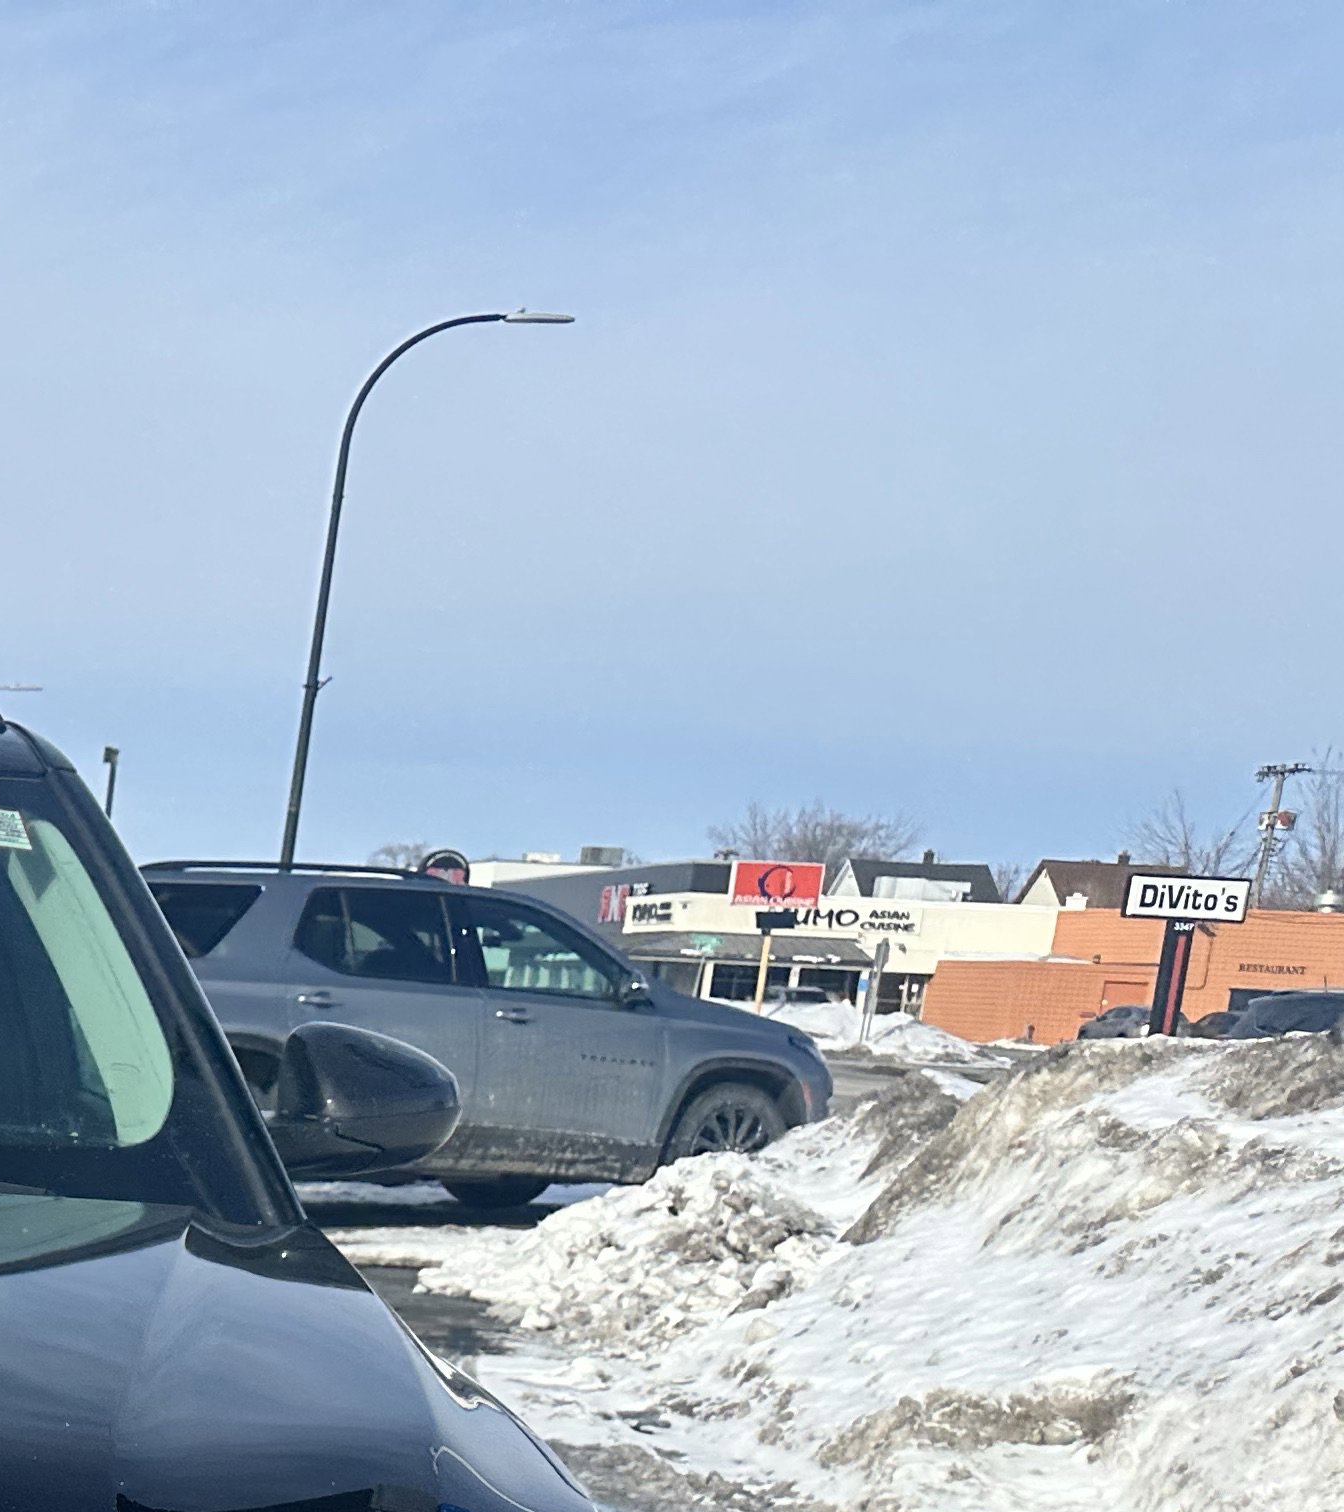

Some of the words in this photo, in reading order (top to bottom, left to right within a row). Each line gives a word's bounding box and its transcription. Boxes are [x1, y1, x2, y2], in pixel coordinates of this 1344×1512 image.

[1138, 884, 1239, 913] DiVito's
[783, 908, 860, 929] UMO
[869, 908, 911, 921] ASIAN
[1238, 963, 1307, 976] RESTAURANT
